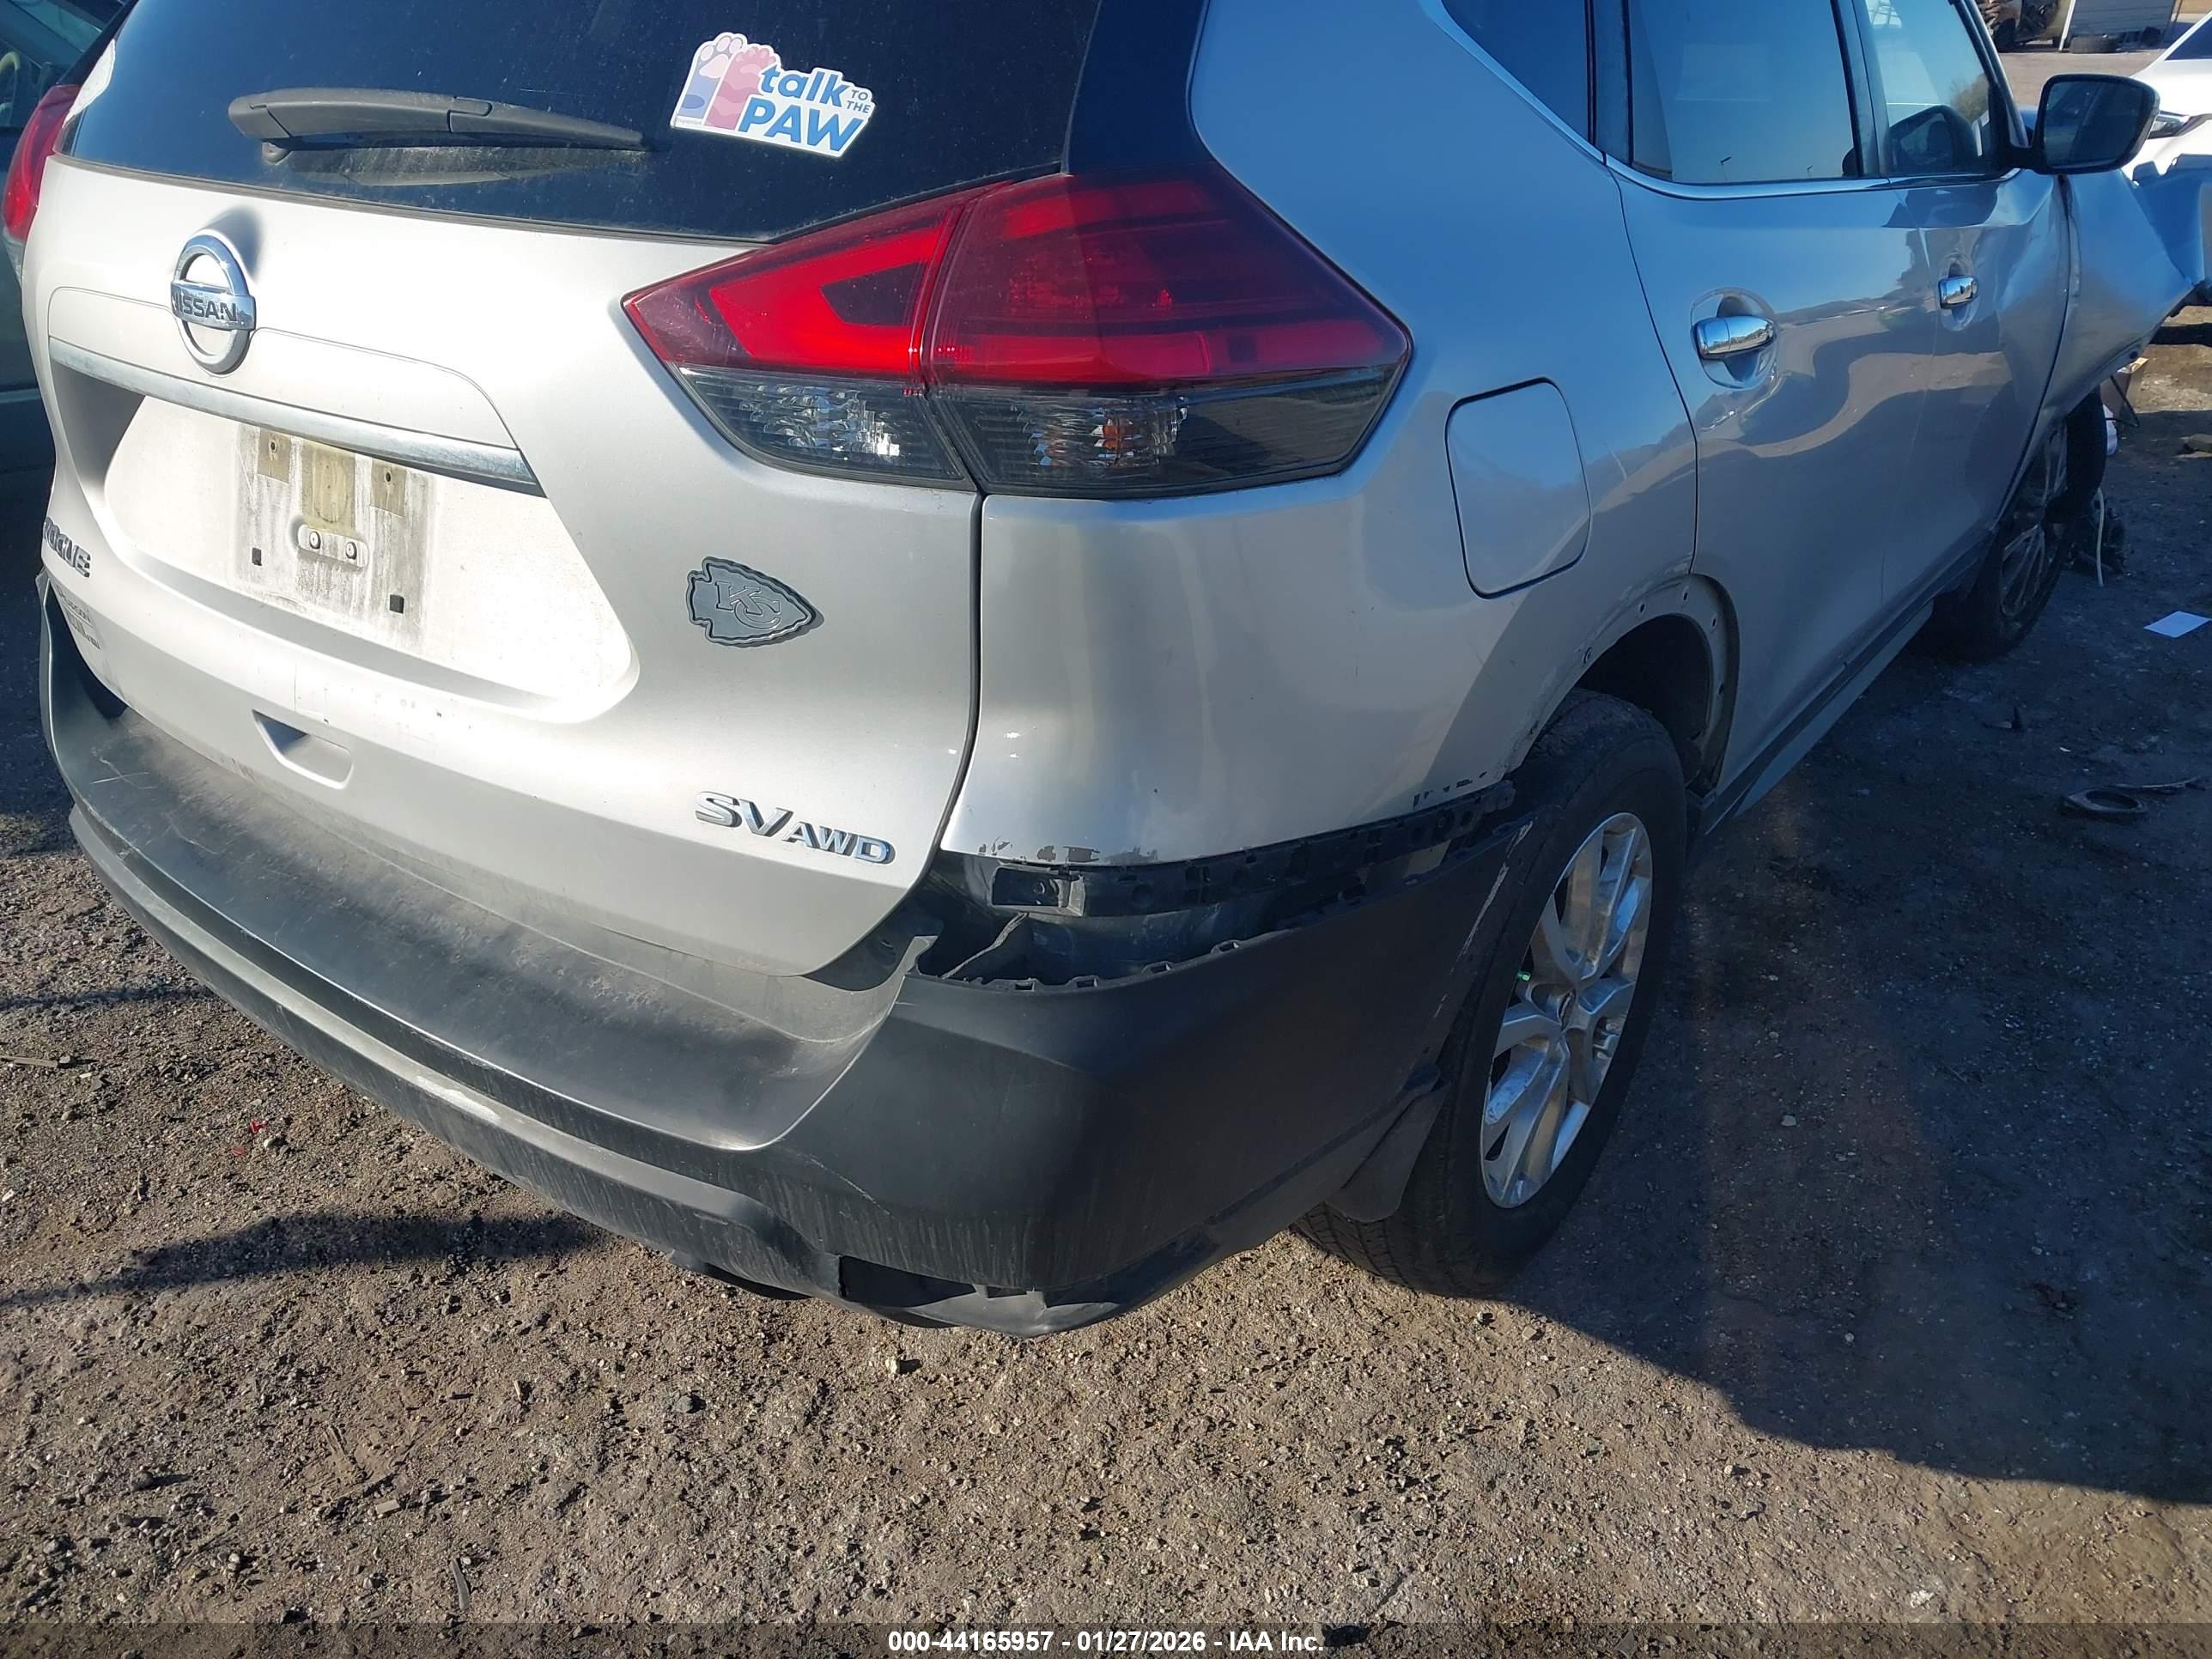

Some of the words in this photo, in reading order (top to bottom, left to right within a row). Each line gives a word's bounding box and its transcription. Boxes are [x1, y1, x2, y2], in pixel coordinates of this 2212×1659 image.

[761, 65, 847, 107] talk
[851, 89, 869, 101] TO
[738, 96, 863, 152] PAW
[846, 100, 872, 114] THE
[172, 292, 239, 322] NISSAN
[695, 791, 794, 837] SV
[781, 821, 897, 865] AWD
